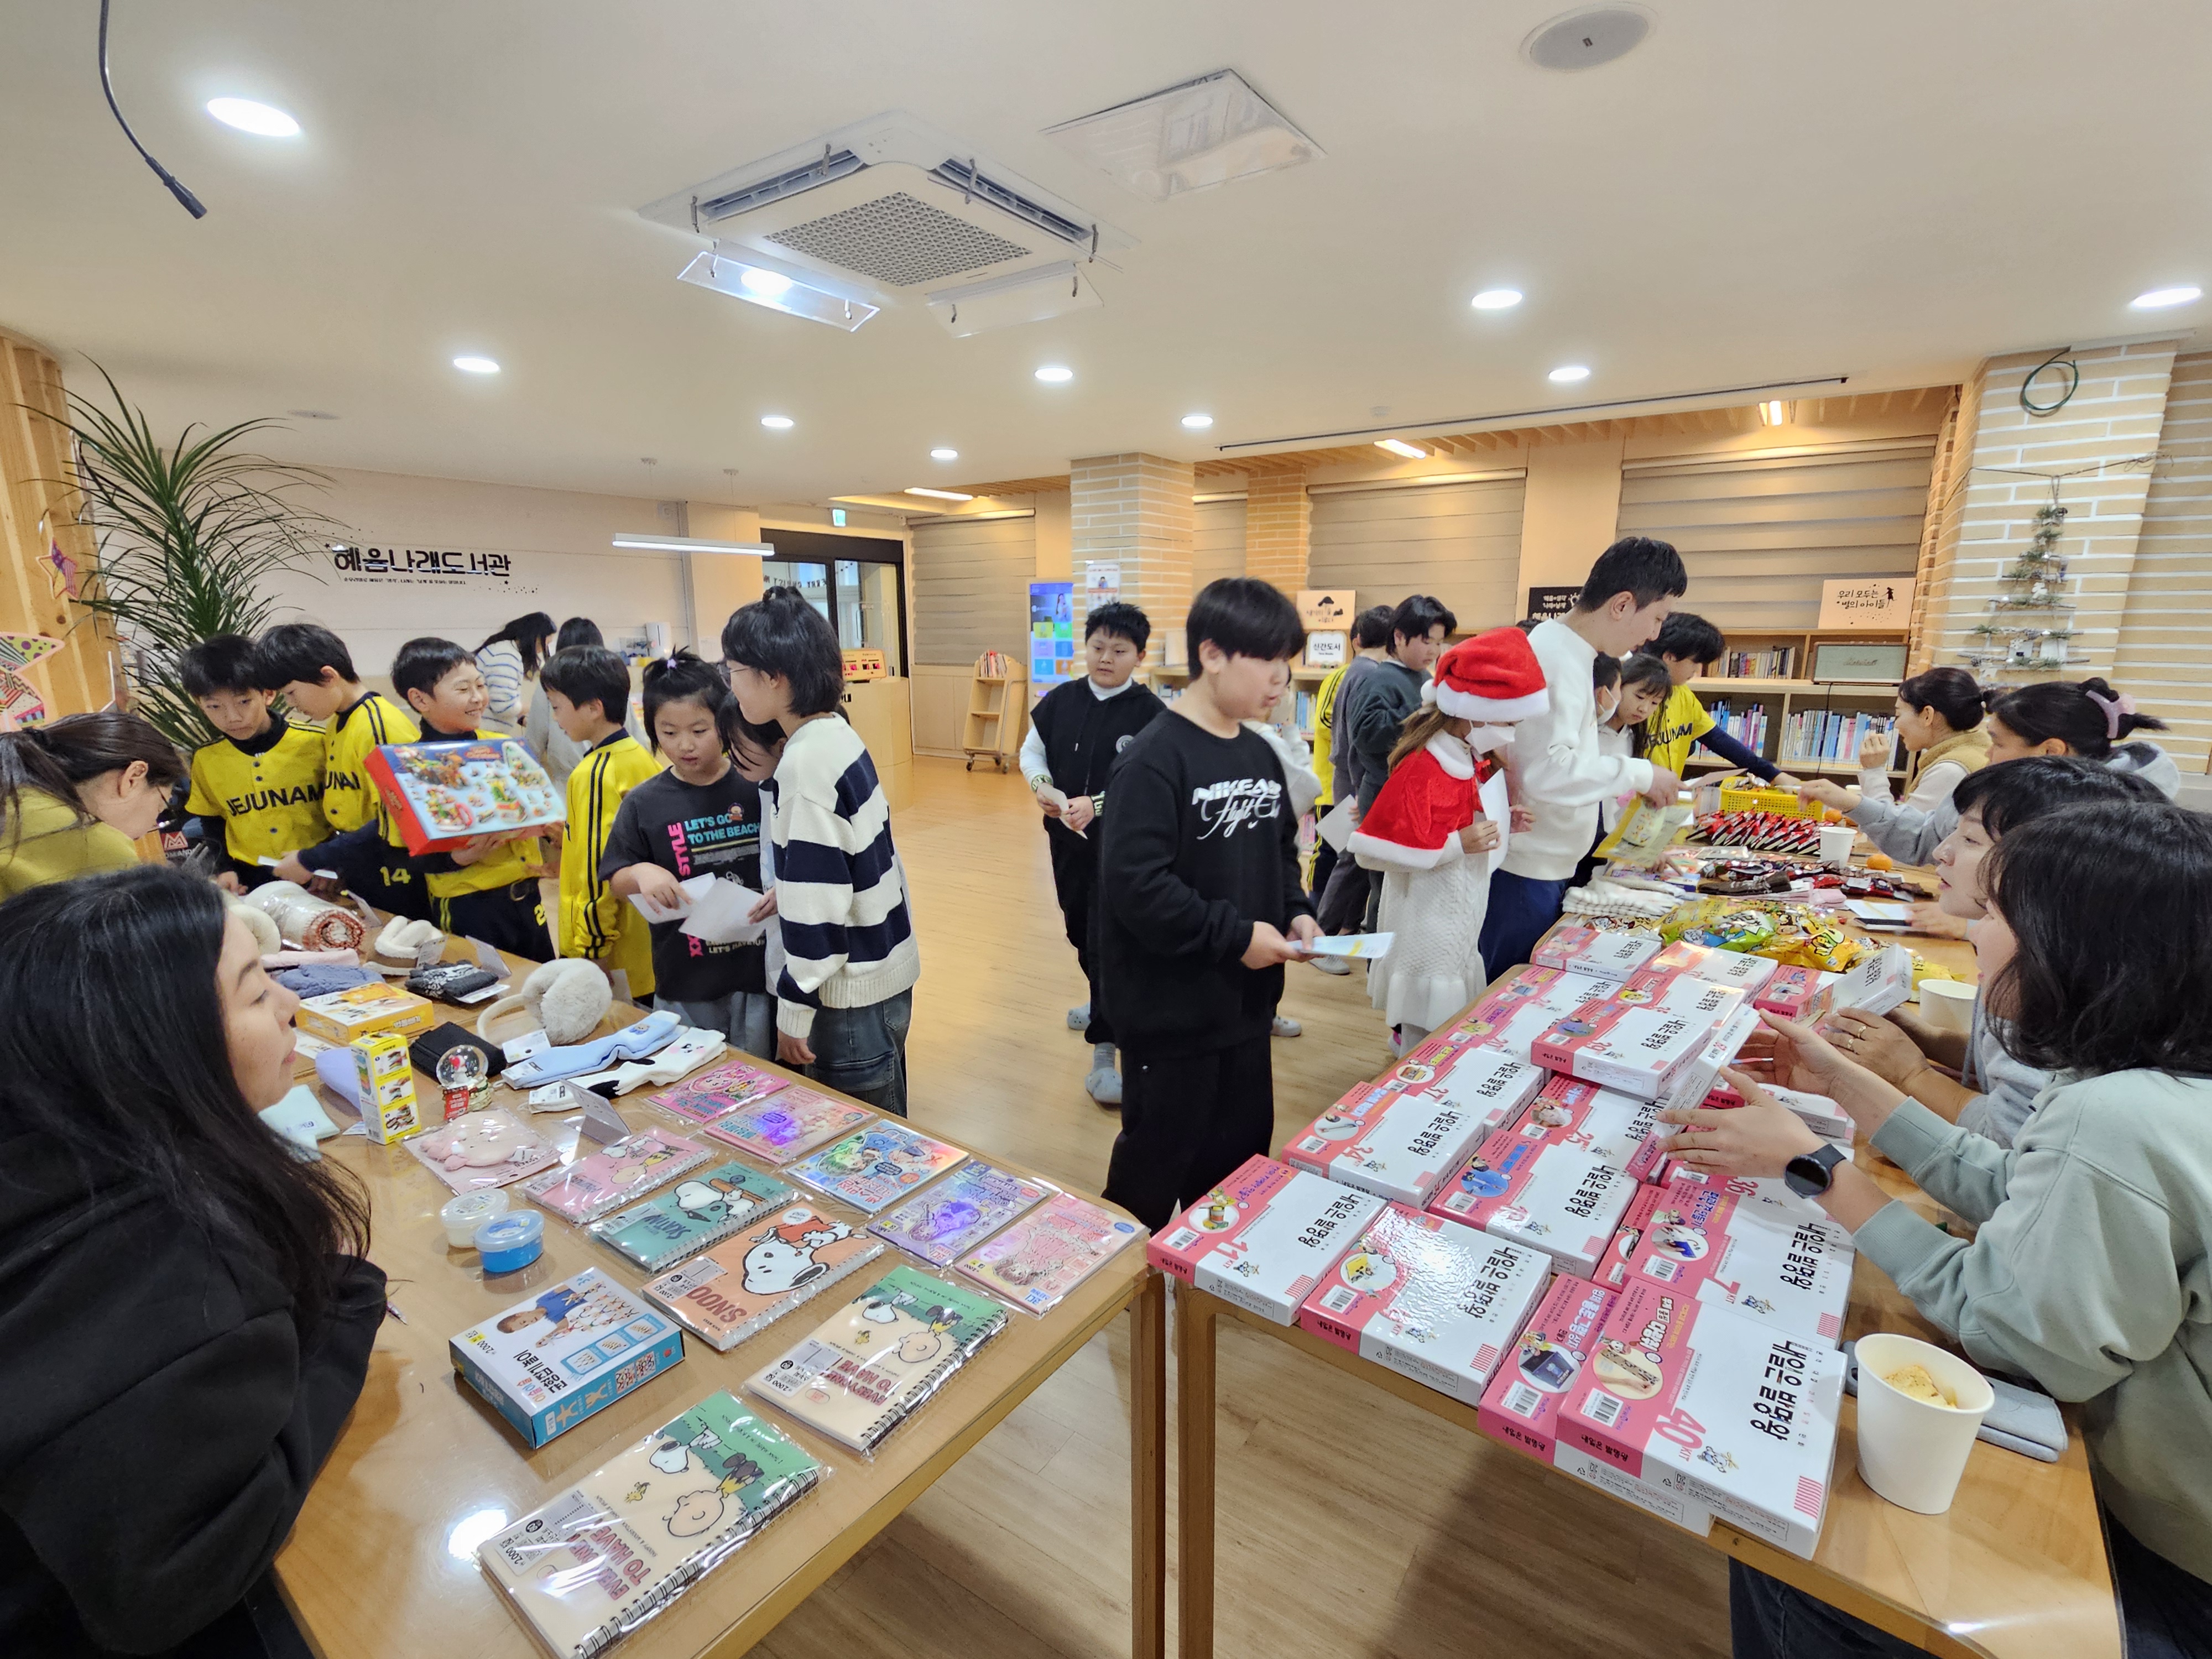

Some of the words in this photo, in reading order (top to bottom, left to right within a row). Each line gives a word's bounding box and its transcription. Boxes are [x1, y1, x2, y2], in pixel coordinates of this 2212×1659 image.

[1838, 591, 1854, 599] 우리
[1855, 589, 1879, 598] 모두는
[1841, 600, 1858, 609] 별의
[1860, 599, 1886, 609] 아이들
[1313, 643, 1340, 651] 신간도서
[226, 780, 325, 817] JEJUNAM
[685, 815, 715, 832] LET'S
[687, 833, 703, 845] TO
[703, 828, 726, 842] THE
[668, 822, 691, 877] STYLE
[379, 866, 411, 887] 14
[1657, 1019, 1682, 1040] 내일은
[1484, 1036, 1507, 1048] 20
[1587, 1040, 1612, 1051] 39
[1641, 1030, 1671, 1052] 발명왕
[1494, 1061, 1520, 1081] 내일은
[1423, 1086, 1448, 1102] 37
[1476, 1075, 1506, 1099] 발명왕
[1428, 1110, 1458, 1134] 내일은
[1407, 1129, 1441, 1157] 발명왕
[1564, 1131, 1594, 1147] 25
[1342, 1144, 1374, 1163] 34
[1582, 1165, 1614, 1191] 내일은
[836, 1178, 883, 1206] 센스만점
[1324, 1193, 1360, 1221] 내일은
[1564, 1188, 1600, 1219] 발명왕
[1690, 1208, 1708, 1228] 만들기
[1297, 1216, 1337, 1249] 발명왕
[1791, 1222, 1826, 1255] 내일은
[928, 1249, 946, 1262] 코디
[1214, 1241, 1248, 1261] 11
[1222, 1257, 1235, 1271] KIT
[1480, 1246, 1518, 1282] 내일은
[1780, 1252, 1820, 1291] 발명왕
[1022, 1291, 1042, 1307] 코디
[1588, 1287, 1606, 1305] 입체
[1724, 1293, 1736, 1304] KIT
[1568, 1297, 1600, 1338] 홀로그램
[1390, 1323, 1403, 1337] KIT
[1638, 1319, 1666, 1352] 다람쥐
[1564, 1332, 1583, 1350] 상자
[512, 1348, 538, 1368] 놀이
[1765, 1342, 1807, 1389] 내일은
[529, 1361, 567, 1394] 균형잡기
[837, 1359, 878, 1387] HAVE
[1750, 1385, 1797, 1441] 발명왕
[1654, 1406, 1708, 1449] 40
[1677, 1444, 1690, 1462] KIT
[564, 1532, 630, 1601] EVERONE
[622, 1556, 653, 1587] TO
